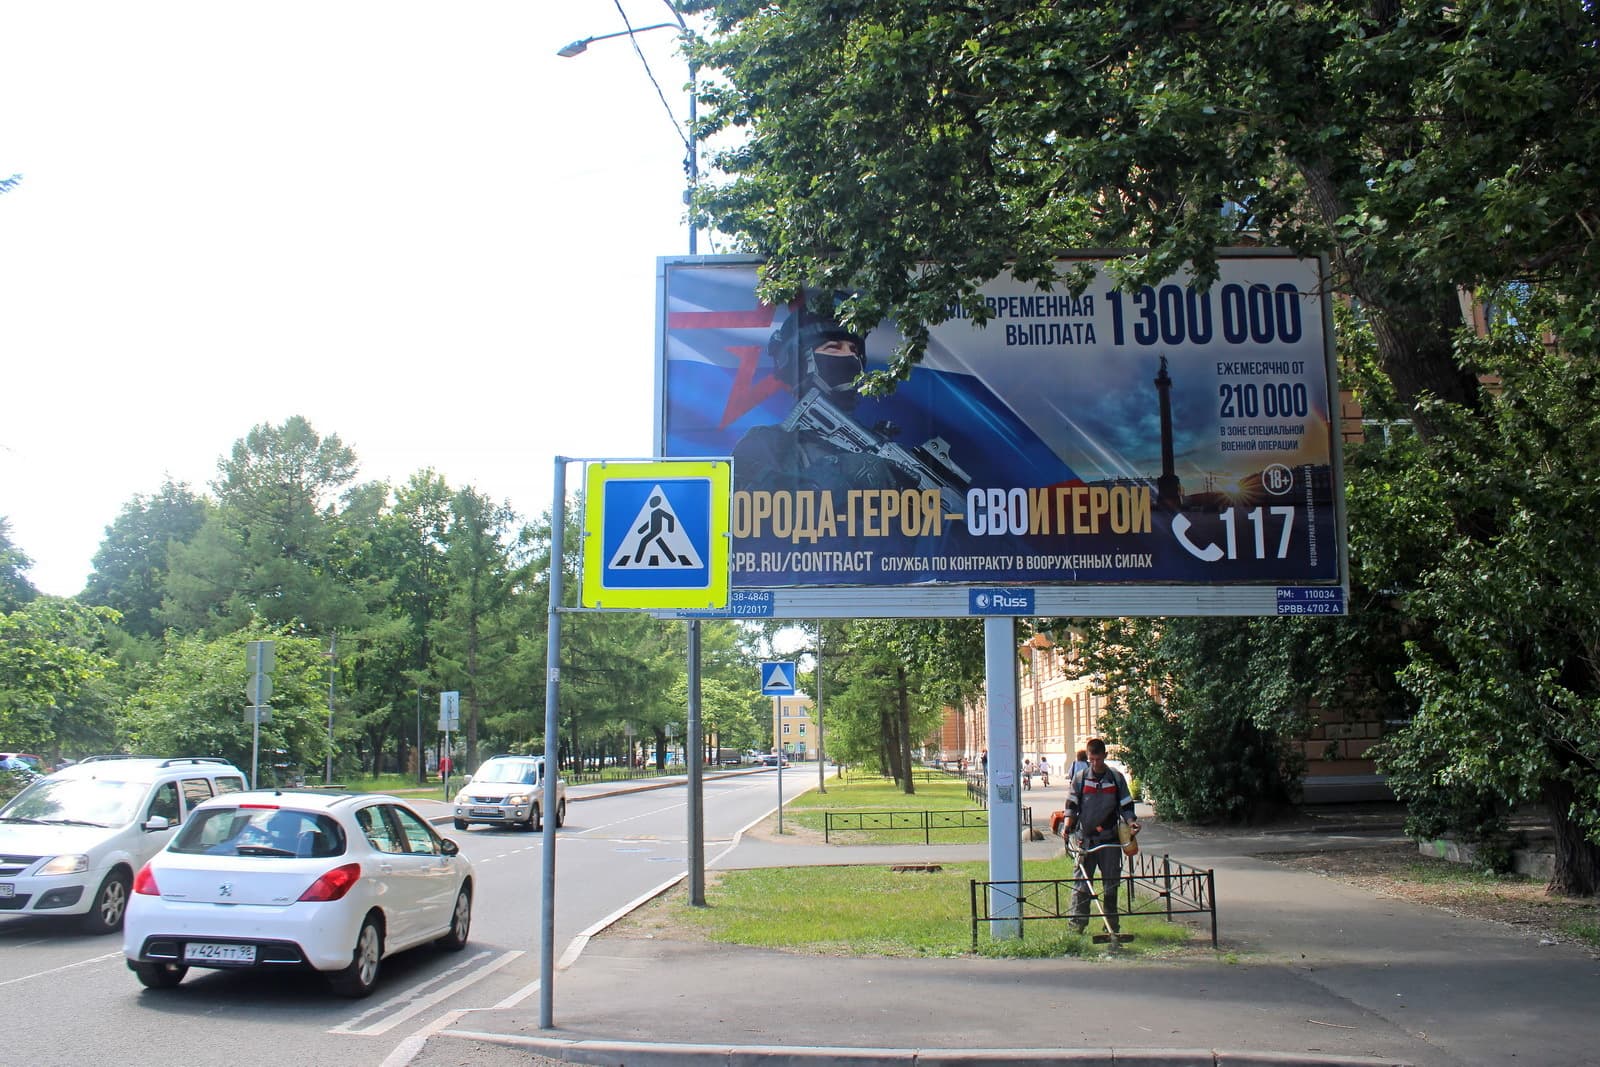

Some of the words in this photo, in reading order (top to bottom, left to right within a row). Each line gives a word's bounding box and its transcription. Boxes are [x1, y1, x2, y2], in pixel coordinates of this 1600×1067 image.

[943, 295, 1095, 321] ИВРЕМЕННАЯ
[1006, 323, 1096, 346] ВЫПЛАТА
[1217, 361, 1290, 375] ЕЖЕМЕСЯЧНО
[1292, 361, 1305, 375] ОТ
[1220, 383, 1259, 418] 210
[1263, 382, 1308, 418] 000
[1220, 426, 1226, 436] В
[1227, 426, 1247, 436] ЗОНЕ
[1248, 424, 1305, 436] СПЕЦИАЛЬНОЙ
[1221, 439, 1256, 452] ВОЕННОЙ
[1258, 439, 1298, 451] ОПЕРАЦИИ
[1268, 470, 1290, 489] 18+
[733, 488, 942, 544] ОРОДА-ГЕРОЯ
[966, 487, 1050, 537] СВОИ
[1055, 486, 1152, 535] ГЕРОИ
[1220, 505, 1295, 560] 117
[881, 556, 929, 572] СЛУЖБА
[931, 556, 947, 571] ПО
[949, 556, 1013, 571] КОНТРАКТУ
[1016, 556, 1023, 570] В
[1027, 554, 1112, 570] ВООРУЖЕННЫХ
[1115, 553, 1153, 569] СИЛАХ
[731, 592, 769, 601] 38-4848
[993, 595, 1028, 607] Russ
[1304, 589, 1335, 599] 110034
